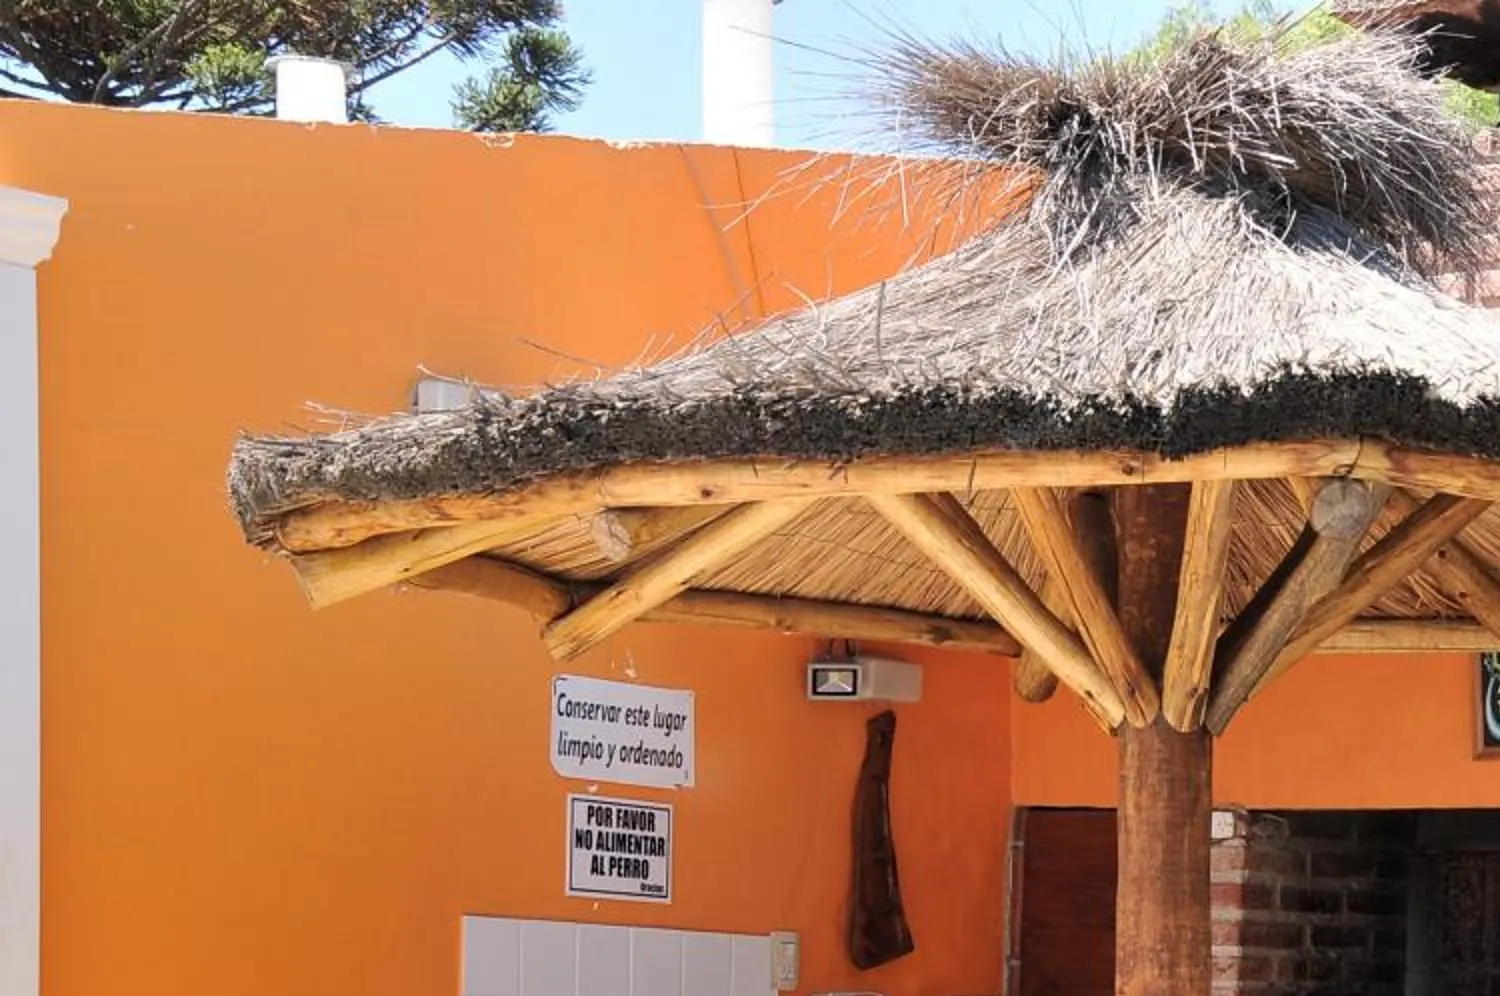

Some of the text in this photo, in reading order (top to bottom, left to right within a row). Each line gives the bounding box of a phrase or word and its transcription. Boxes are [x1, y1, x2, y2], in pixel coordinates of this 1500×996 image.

[557, 692, 687, 737] Conservar este lugar
[557, 730, 683, 769] limpio y ordenado
[587, 805, 655, 832] POR FAVOR
[575, 828, 666, 857] NO ALIMENTAR
[590, 854, 649, 880] AL PERRO
